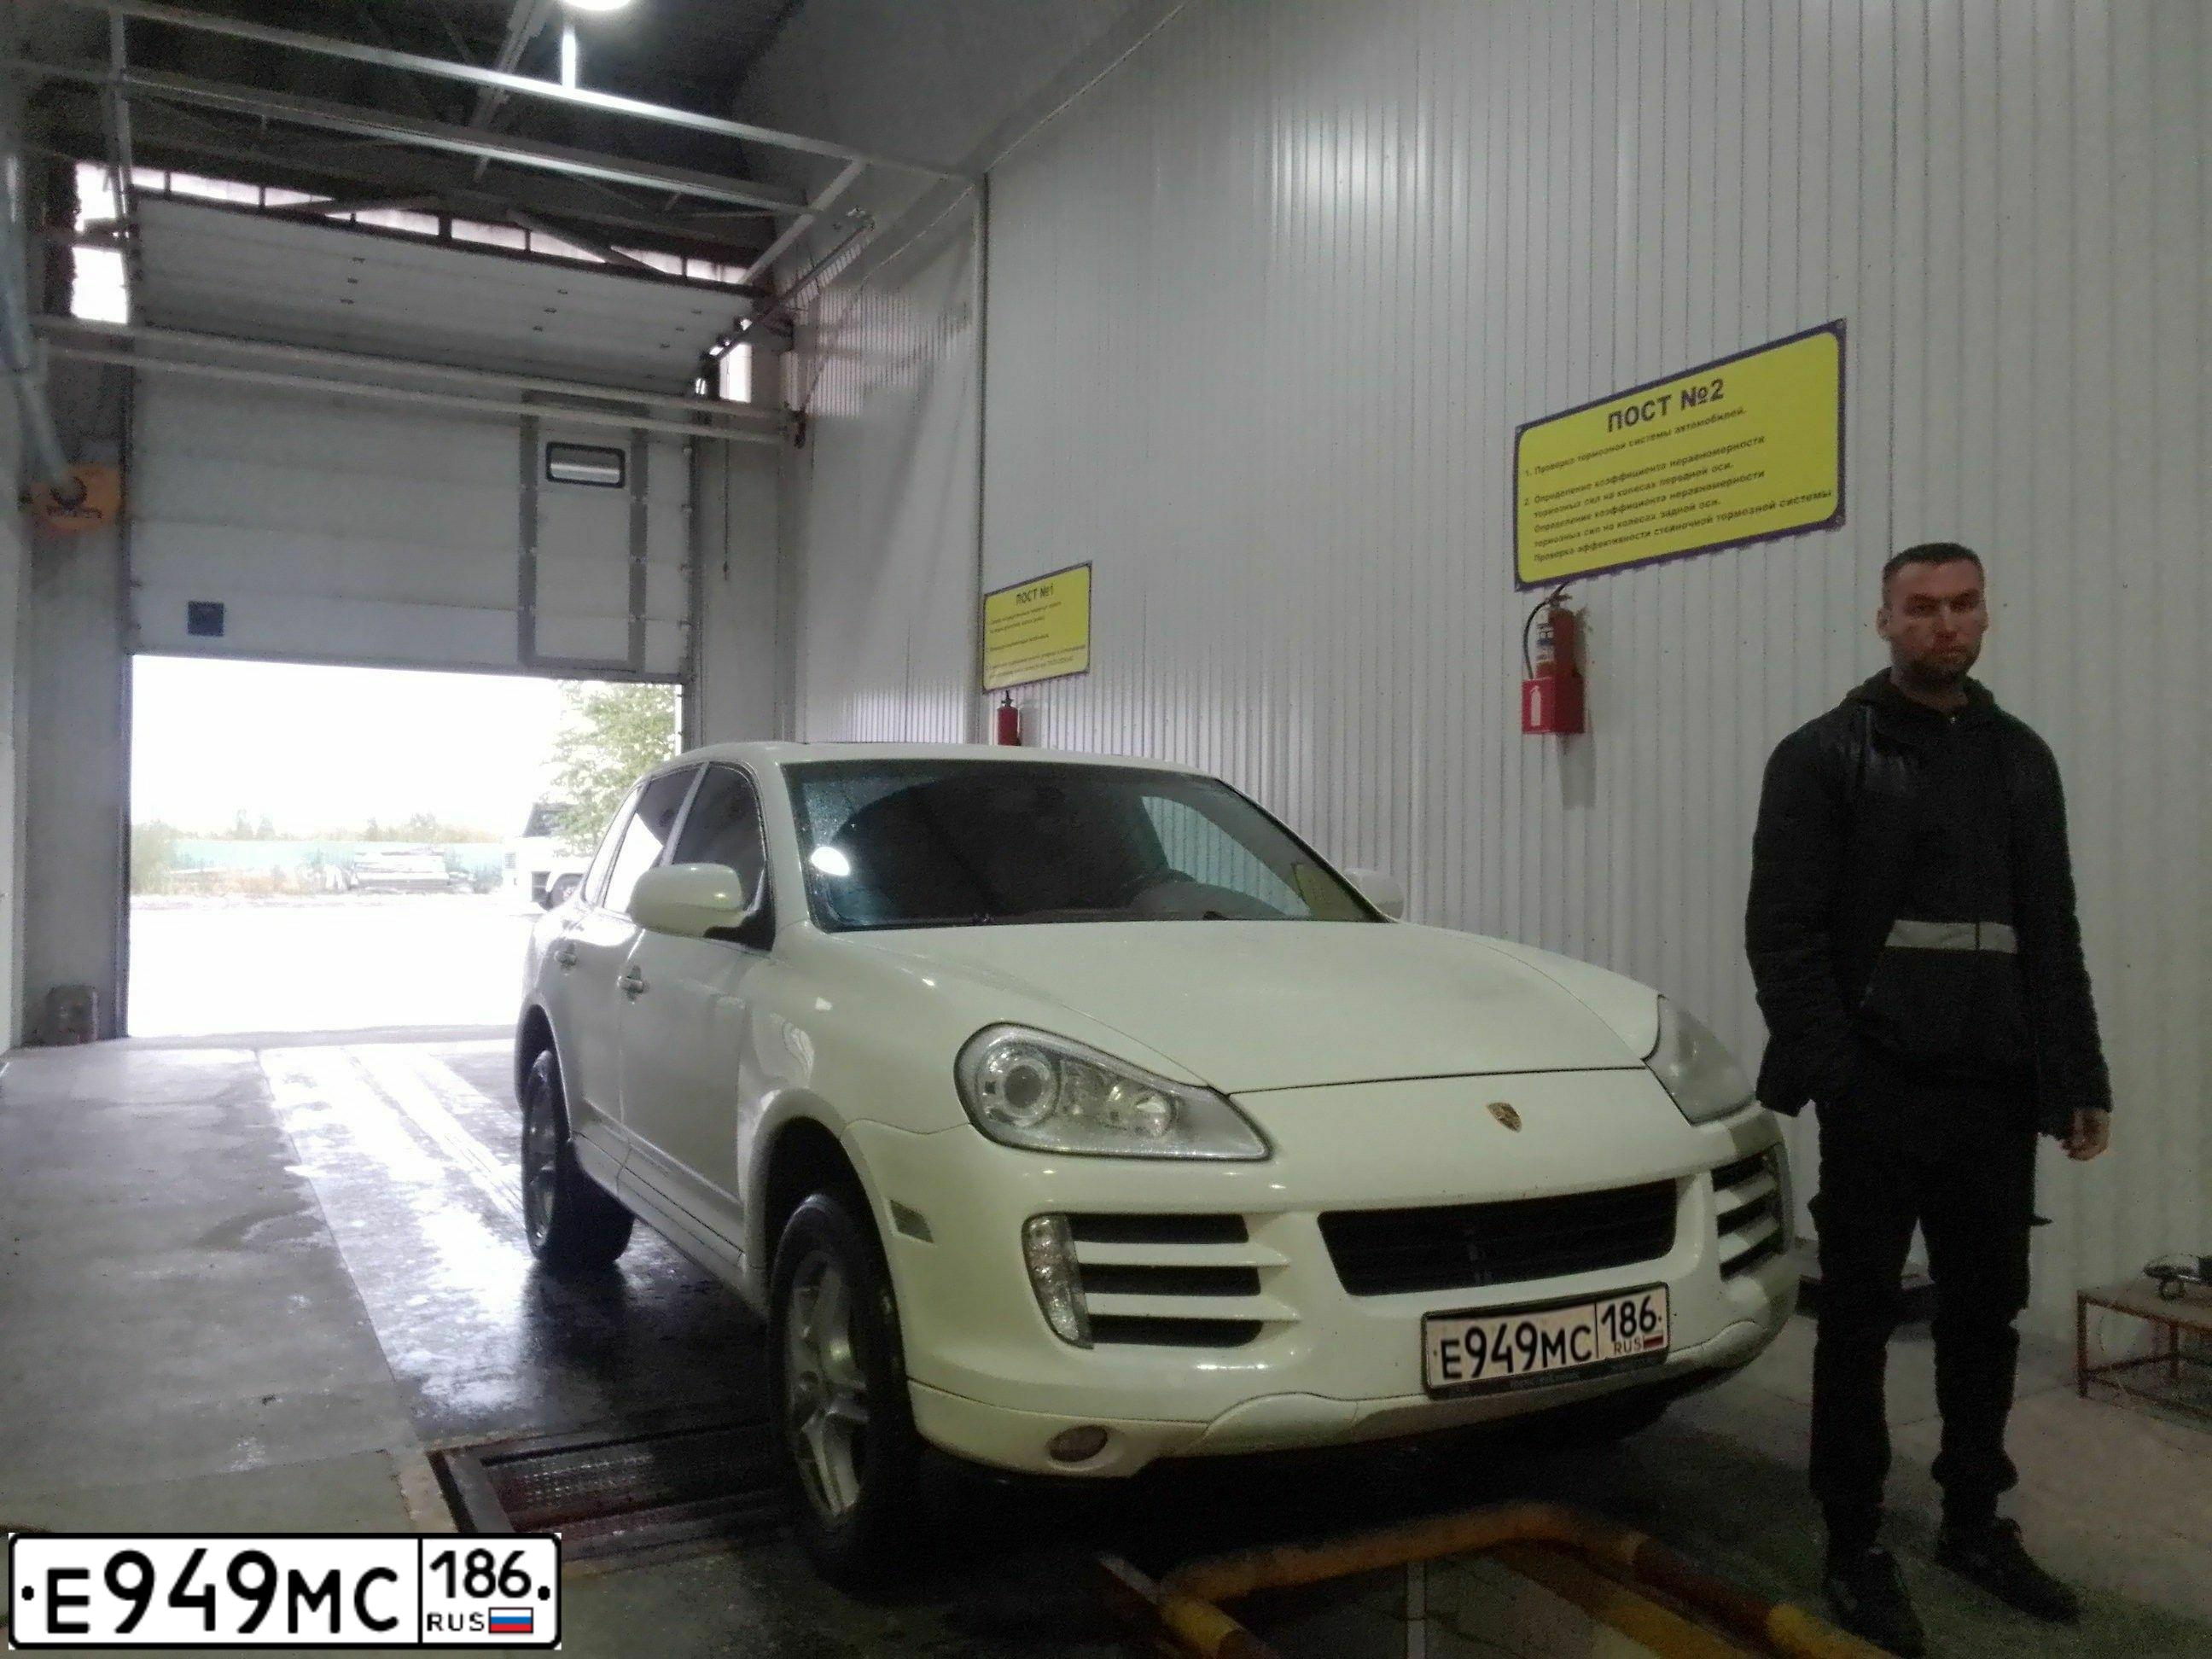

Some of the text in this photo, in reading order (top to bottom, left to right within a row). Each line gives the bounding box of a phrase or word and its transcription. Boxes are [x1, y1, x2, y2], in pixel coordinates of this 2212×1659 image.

[1606, 378, 1725, 433] ПОСТ №2
[1628, 430, 1671, 447] системы
[1669, 436, 1766, 467] неравномерности
[1669, 470, 1766, 500] неравномерности
[1716, 501, 1777, 522] тормозной
[1779, 489, 1833, 508] системы
[1616, 514, 1656, 529] колесах
[1601, 1295, 1657, 1343] 186
[1614, 1335, 1643, 1355] RUS
